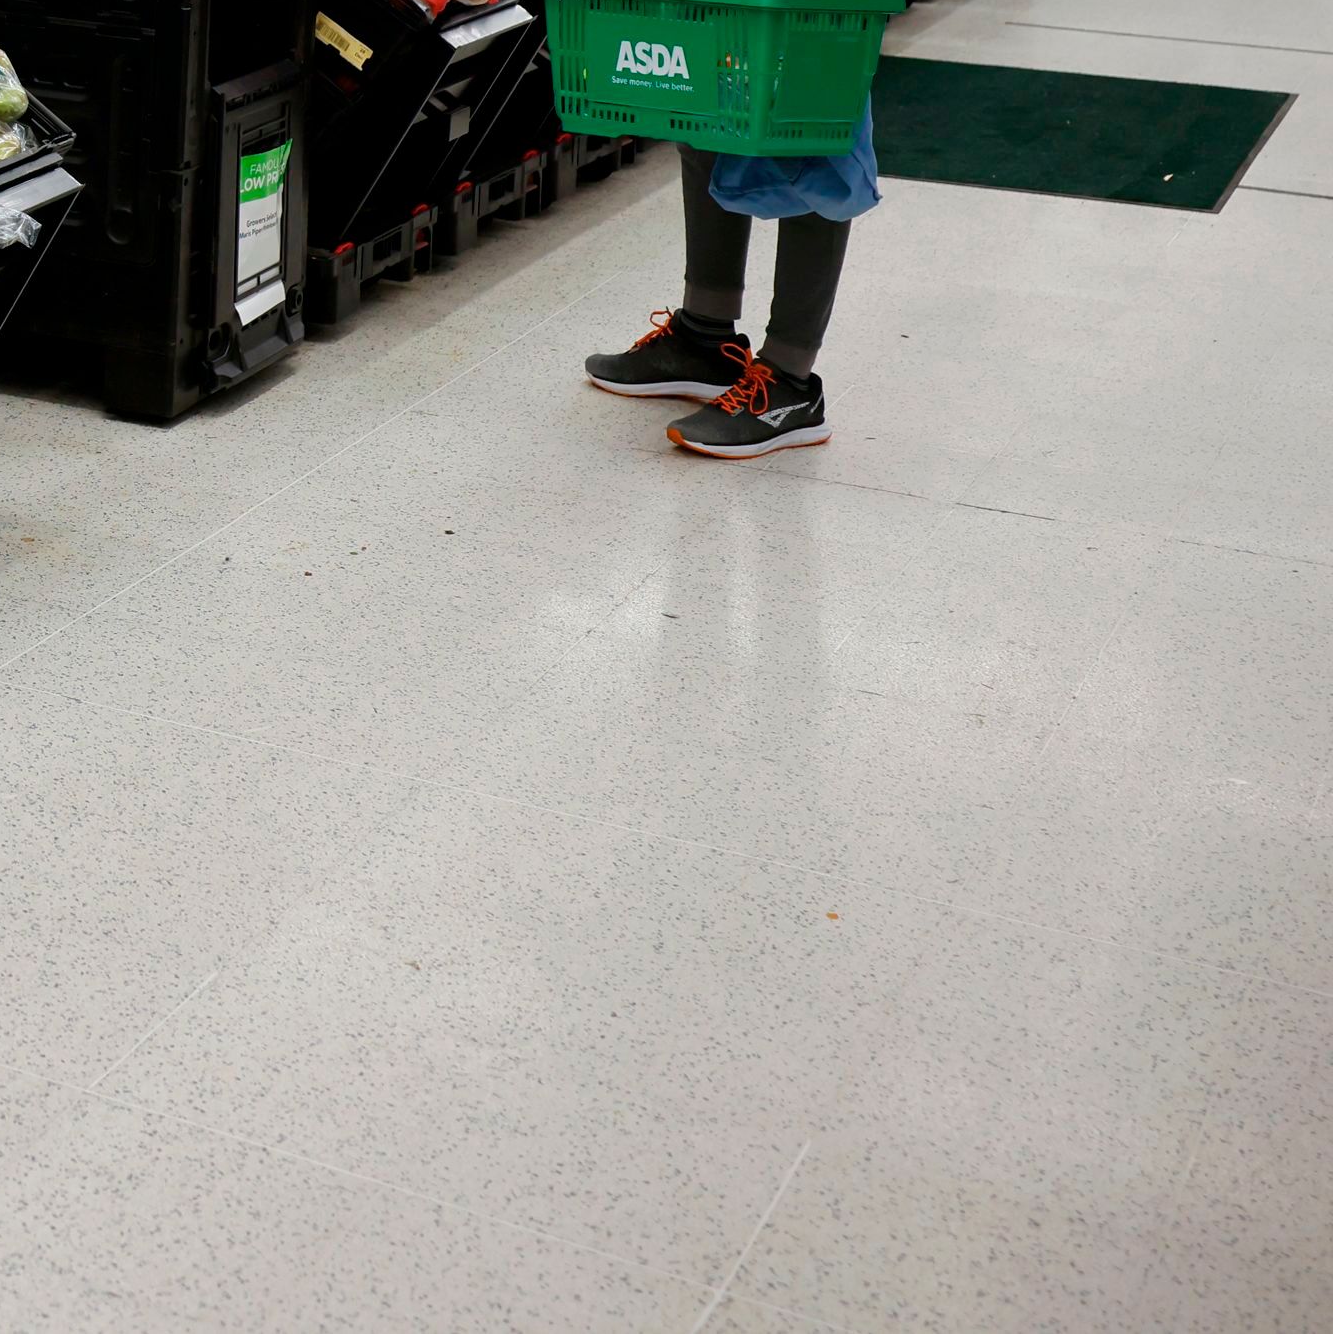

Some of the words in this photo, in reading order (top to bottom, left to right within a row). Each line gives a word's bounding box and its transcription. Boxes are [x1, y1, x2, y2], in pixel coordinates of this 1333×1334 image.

[616, 40, 690, 79] ASDA
[612, 75, 627, 85] Save
[655, 81, 670, 90] Live
